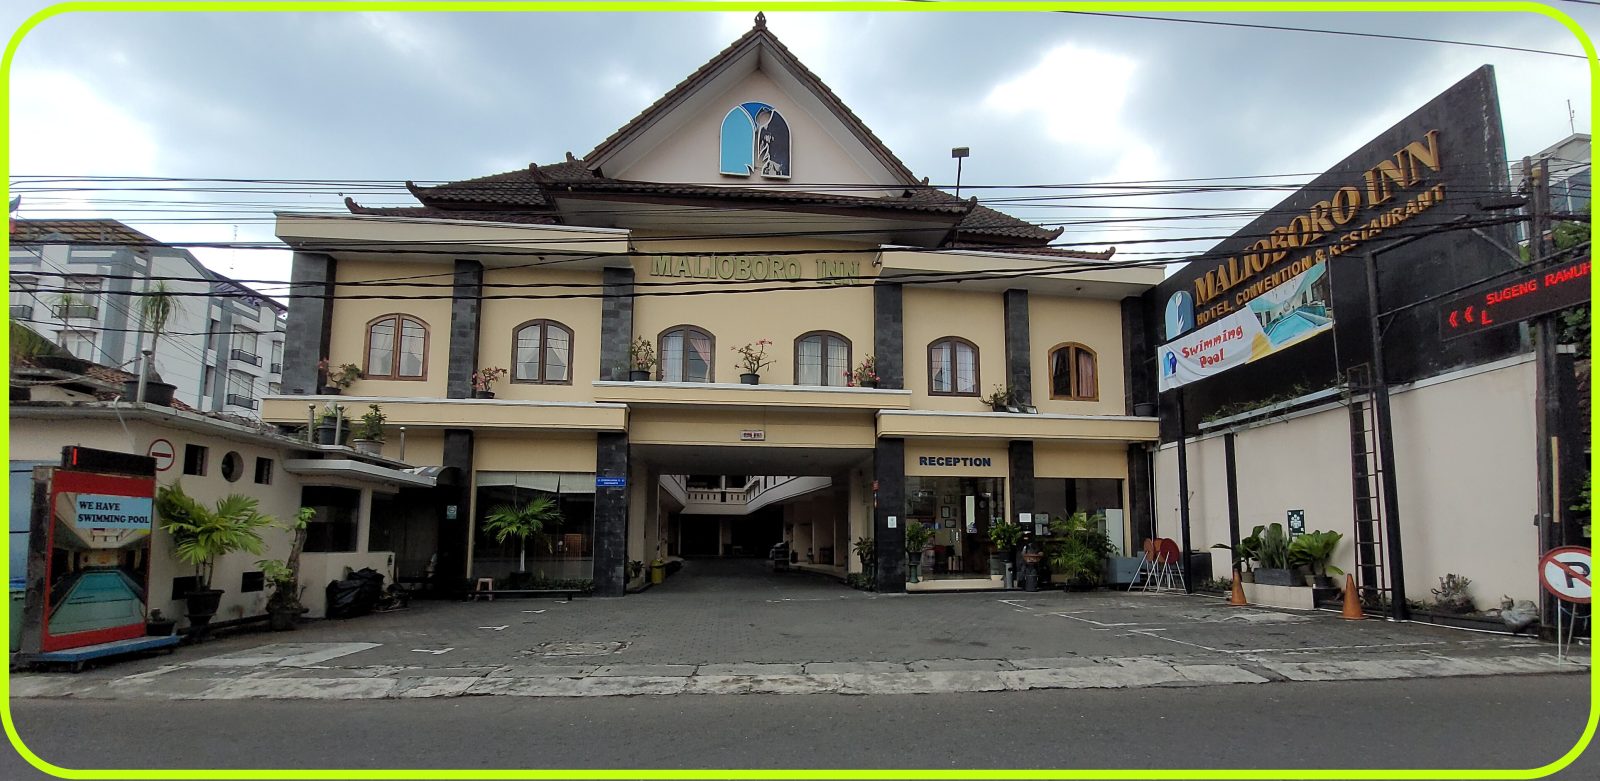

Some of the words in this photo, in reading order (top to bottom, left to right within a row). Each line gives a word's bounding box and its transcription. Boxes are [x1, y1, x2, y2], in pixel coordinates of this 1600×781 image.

[1194, 186, 1361, 307] MALIOBORO
[1362, 129, 1441, 209] INN
[1235, 256, 1313, 306] CONVENTION
[1315, 248, 1327, 264] &
[1329, 182, 1446, 257] RESTAURANT
[649, 254, 802, 281] MALIOBORO
[816, 258, 861, 286] INN
[1486, 279, 1538, 306] SUGENG
[1544, 261, 1592, 288] RAWUH
[1181, 325, 1244, 359] Swimming
[1200, 347, 1225, 369] Pool
[919, 456, 991, 467] RECEPTION
[78, 514, 126, 523] SWIMMING
[128, 515, 150, 524] POOL
[79, 501, 94, 510] WE
[95, 502, 121, 511] HAVE
[1561, 561, 1591, 588] P
